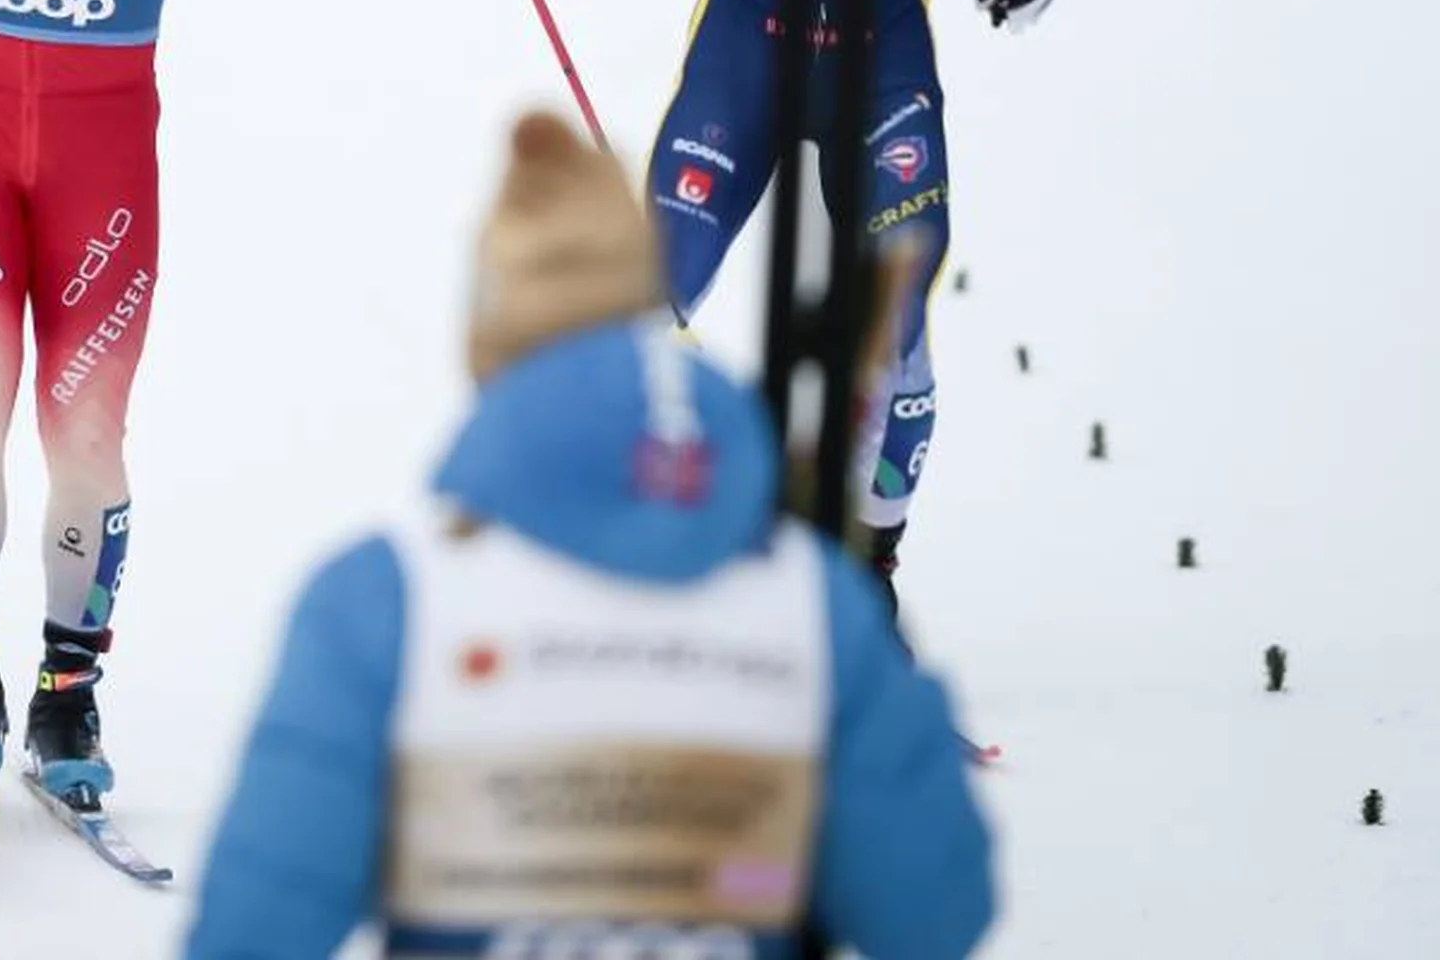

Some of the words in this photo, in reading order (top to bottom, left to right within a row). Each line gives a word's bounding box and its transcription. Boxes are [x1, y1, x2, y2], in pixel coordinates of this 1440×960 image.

[62, 208, 132, 307] odlo
[867, 188, 941, 234] CRAFT
[51, 268, 150, 404] RAIFFEISEN
